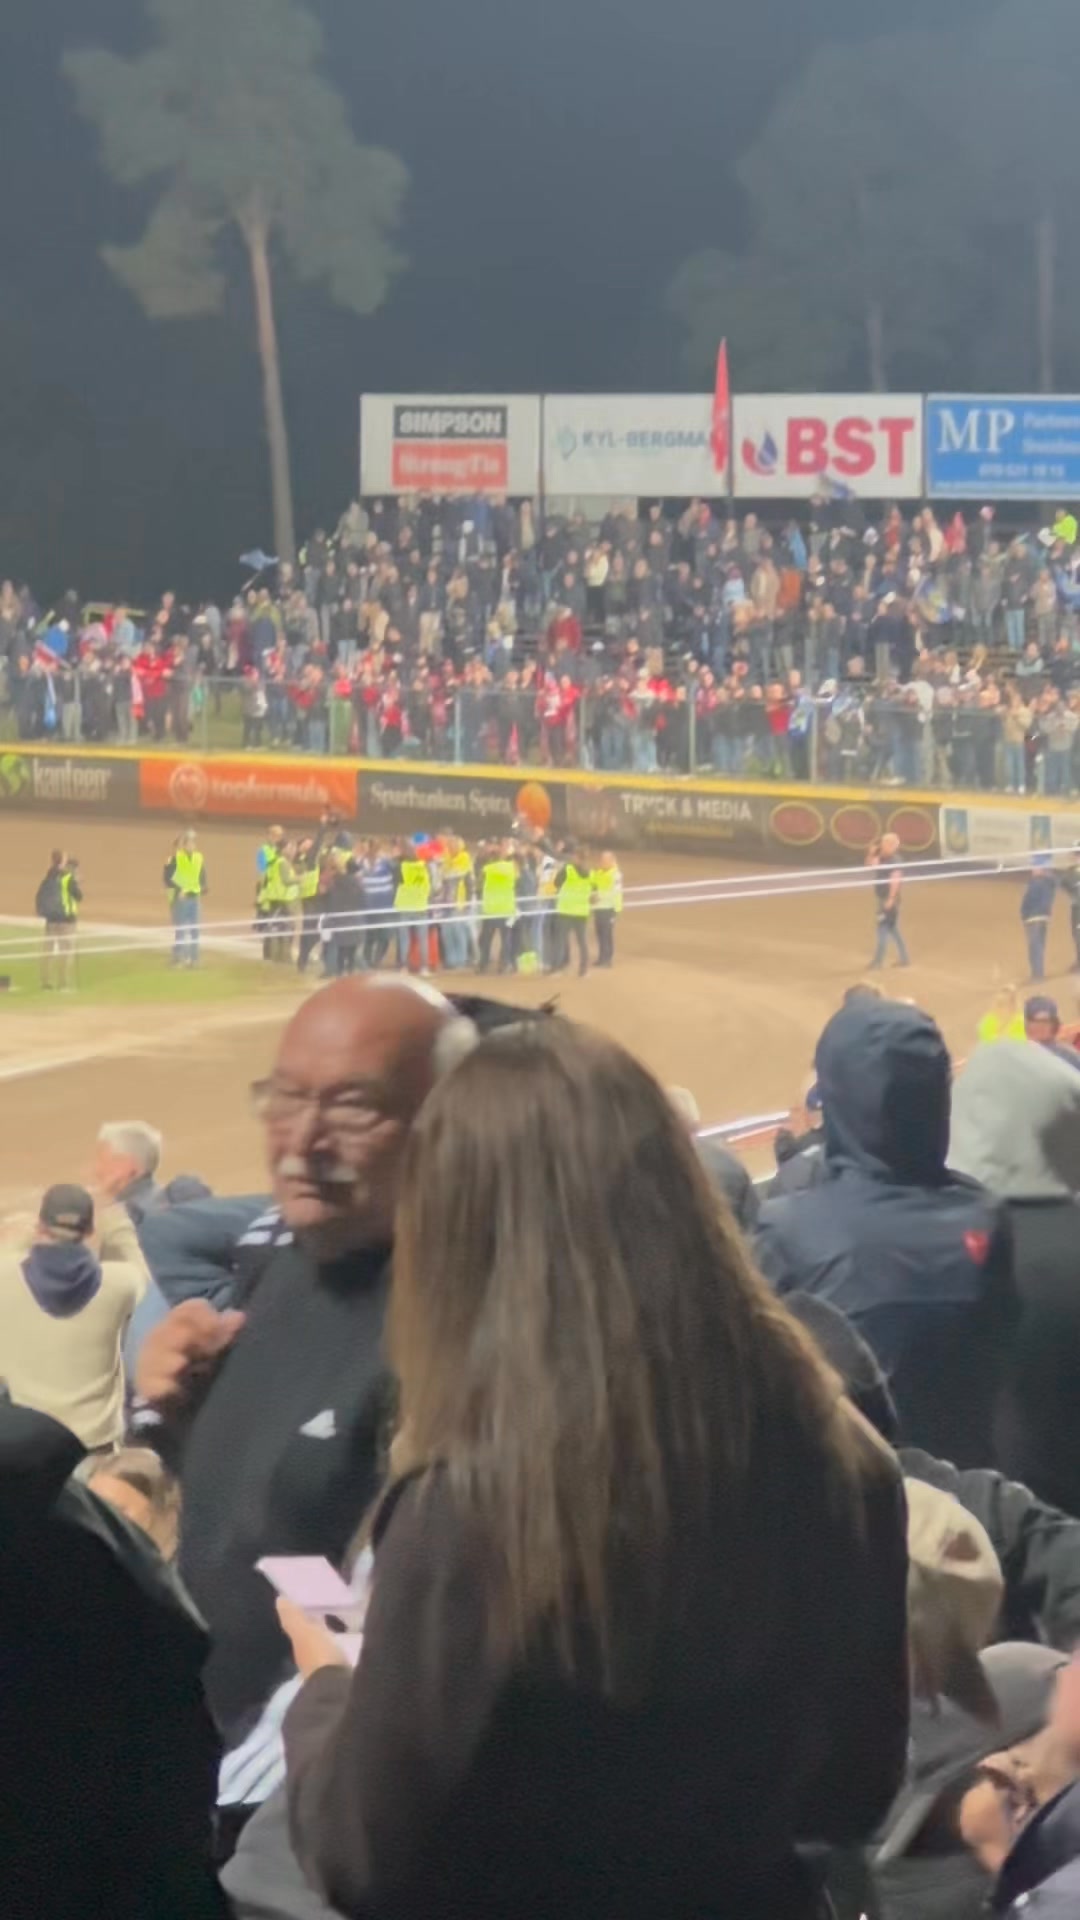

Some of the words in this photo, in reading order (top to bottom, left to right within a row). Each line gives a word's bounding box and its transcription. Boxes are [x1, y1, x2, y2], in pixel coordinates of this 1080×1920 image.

[400, 411, 502, 434] SIMPSON
[937, 408, 1015, 453] MP
[582, 430, 712, 449] KYL-BERGMA
[786, 417, 915, 476] BST
[697, 799, 752, 821] MEDIA
